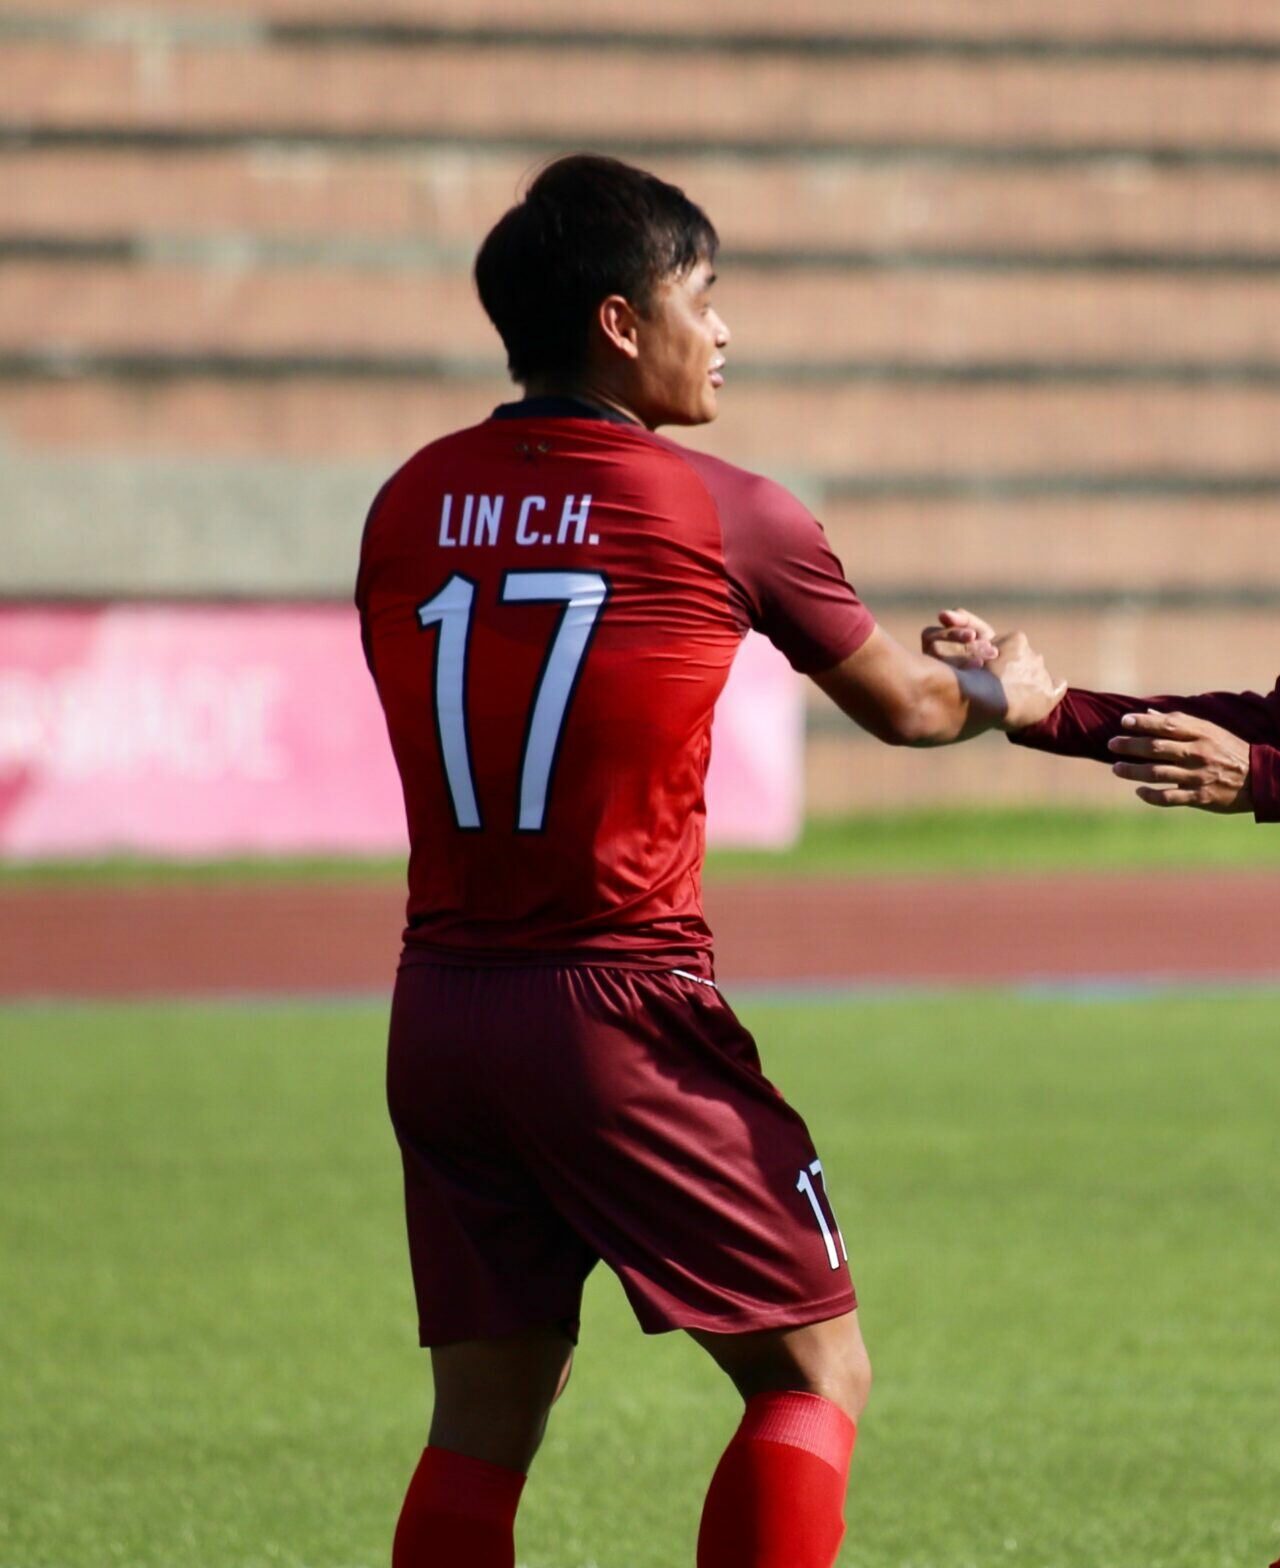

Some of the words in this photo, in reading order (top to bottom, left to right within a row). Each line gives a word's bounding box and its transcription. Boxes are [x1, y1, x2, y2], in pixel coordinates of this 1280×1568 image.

[438, 494, 503, 547] LIN
[515, 493, 600, 546] C.H.
[415, 568, 612, 835] 17
